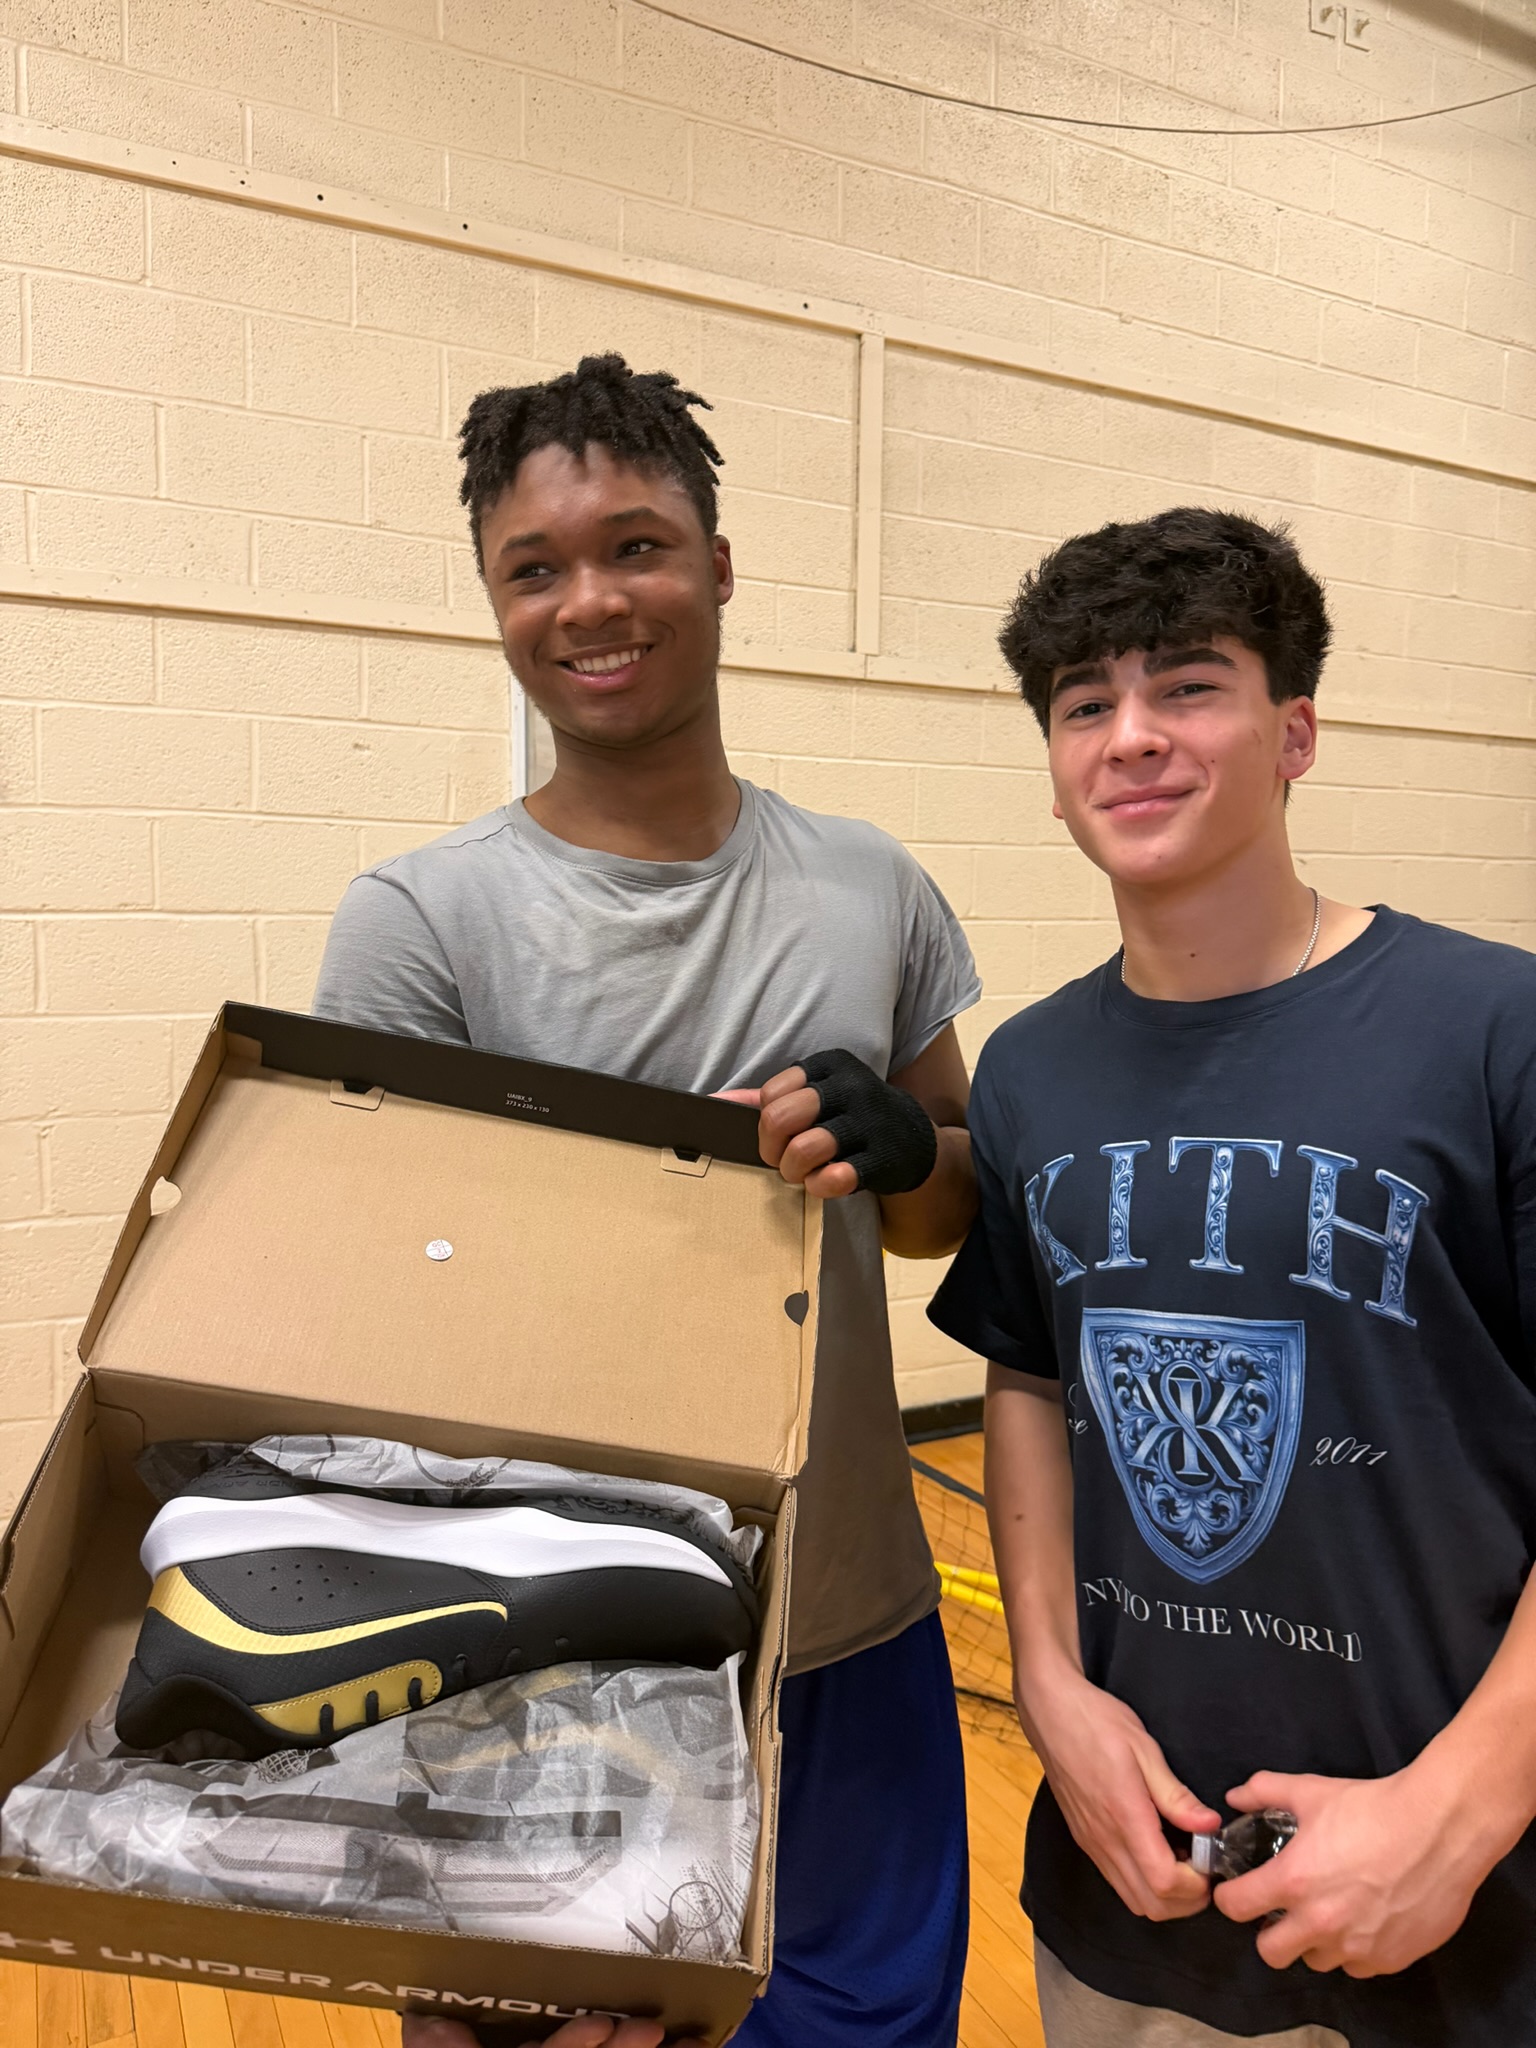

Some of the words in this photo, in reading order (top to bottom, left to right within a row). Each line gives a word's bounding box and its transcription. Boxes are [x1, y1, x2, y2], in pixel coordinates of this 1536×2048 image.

[1024, 1136, 1430, 1328] KITH
[1309, 1436, 1389, 1468] 2011
[1081, 1577, 1123, 1606] NY
[1157, 1600, 1232, 1635] THE
[1239, 1609, 1363, 1663] WORLD
[100, 1946, 332, 1988] UNDER
[344, 1979, 631, 2020] ARMOU
